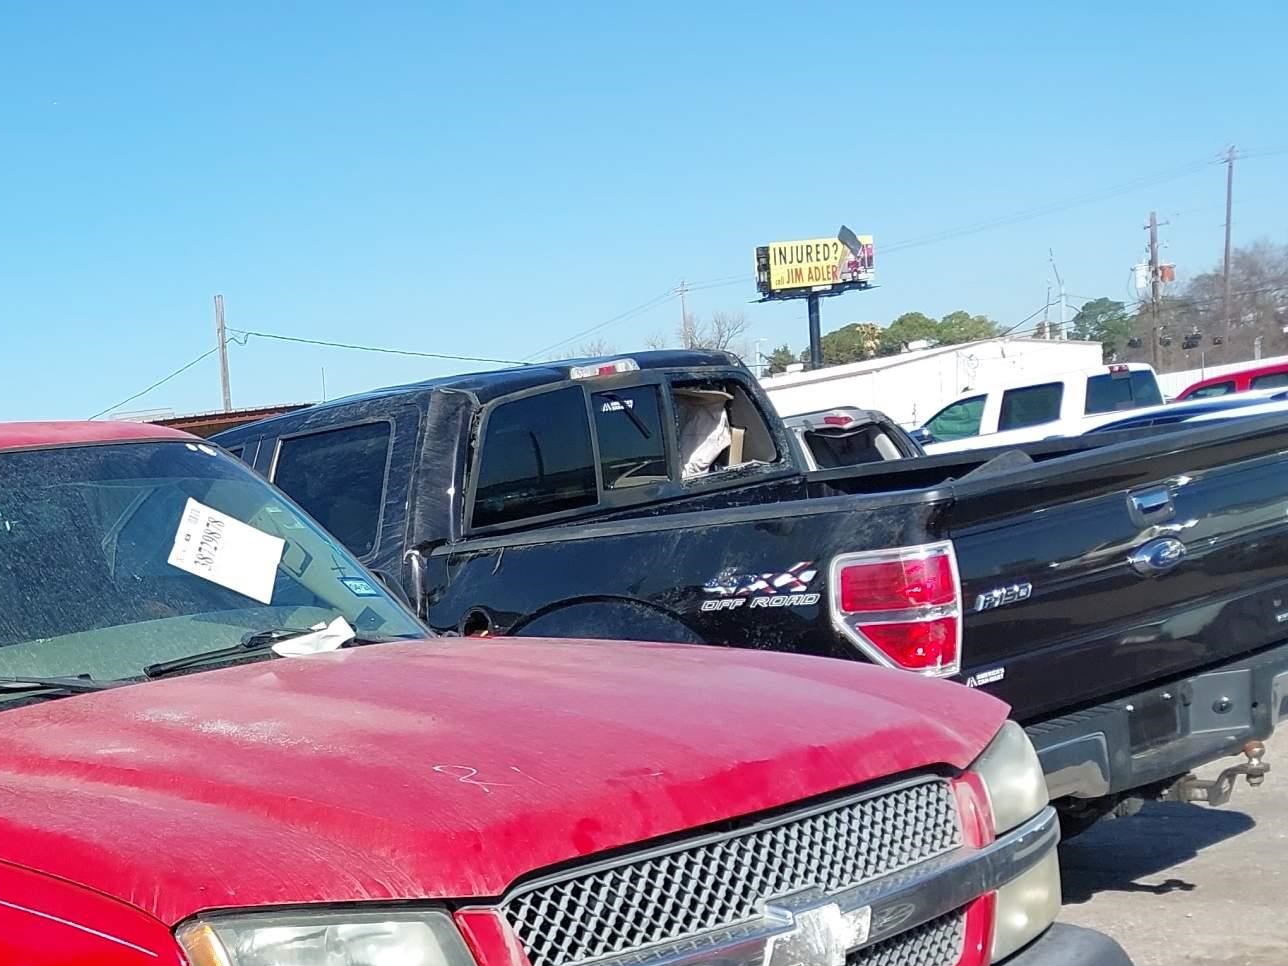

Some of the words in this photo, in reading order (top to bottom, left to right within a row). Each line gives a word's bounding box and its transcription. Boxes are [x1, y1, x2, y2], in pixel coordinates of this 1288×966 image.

[773, 242, 839, 266] INJURED?
[786, 267, 804, 285] JIM
[807, 264, 839, 283] ADLER
[193, 515, 225, 572] 38729878
[701, 598, 747, 612] OFF
[750, 594, 821, 608] ROAD
